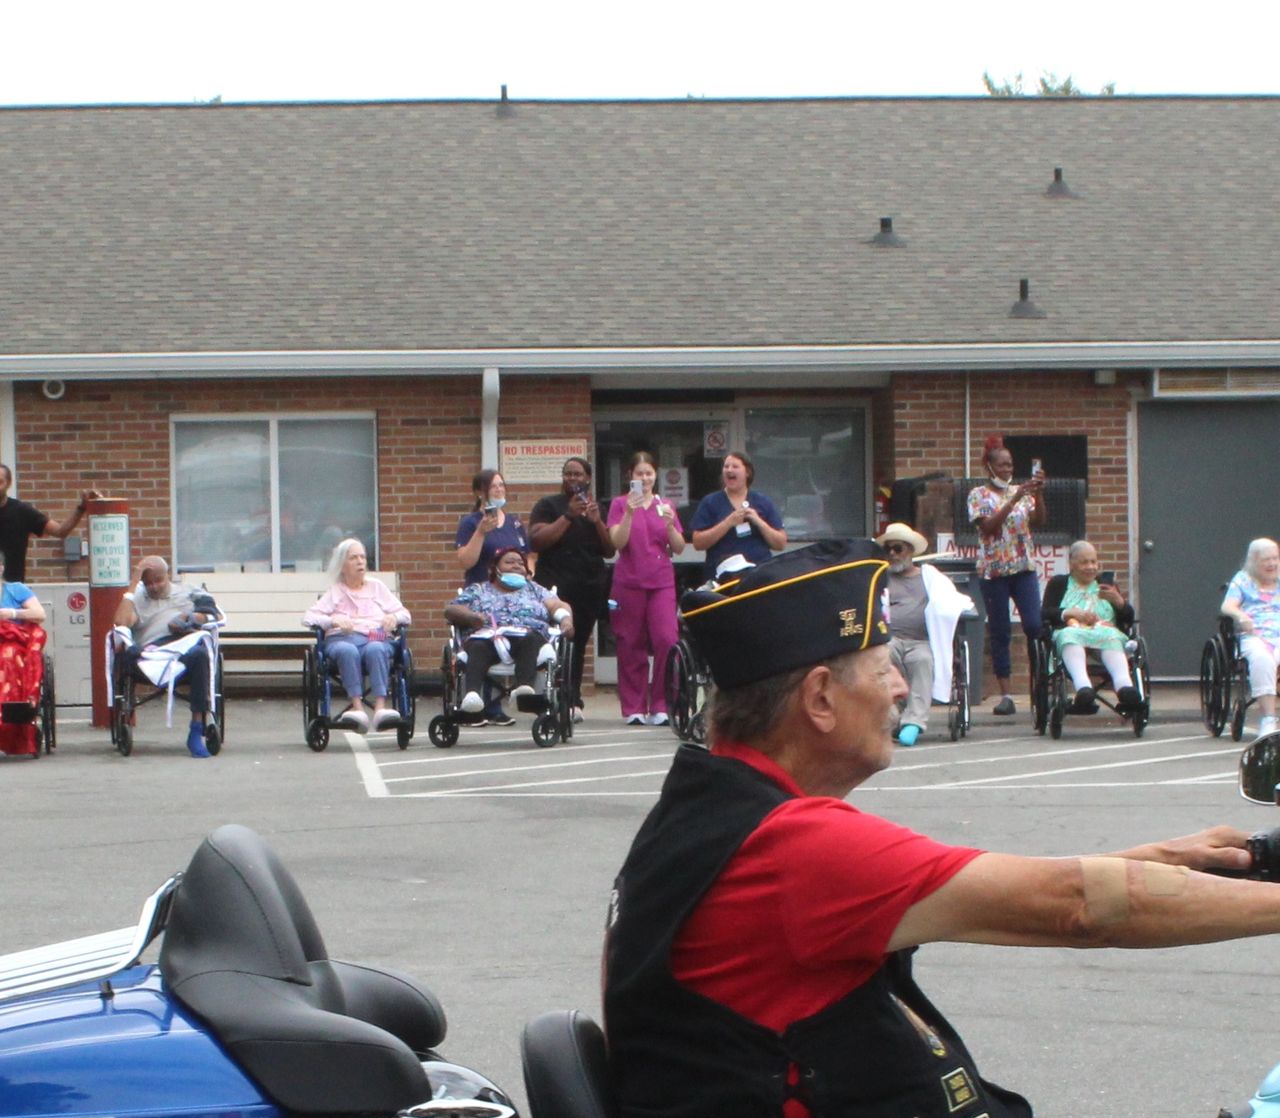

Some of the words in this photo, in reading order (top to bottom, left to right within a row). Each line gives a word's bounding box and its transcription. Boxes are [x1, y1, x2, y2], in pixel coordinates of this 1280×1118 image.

[505, 447, 517, 455] NO
[521, 446, 582, 455] TRESPASSING
[93, 521, 123, 531] RESERVED
[102, 534, 115, 542] FOR
[93, 546, 125, 554] EMPLOYEE
[98, 570, 120, 578] MONTH
[70, 615, 85, 624] LG
